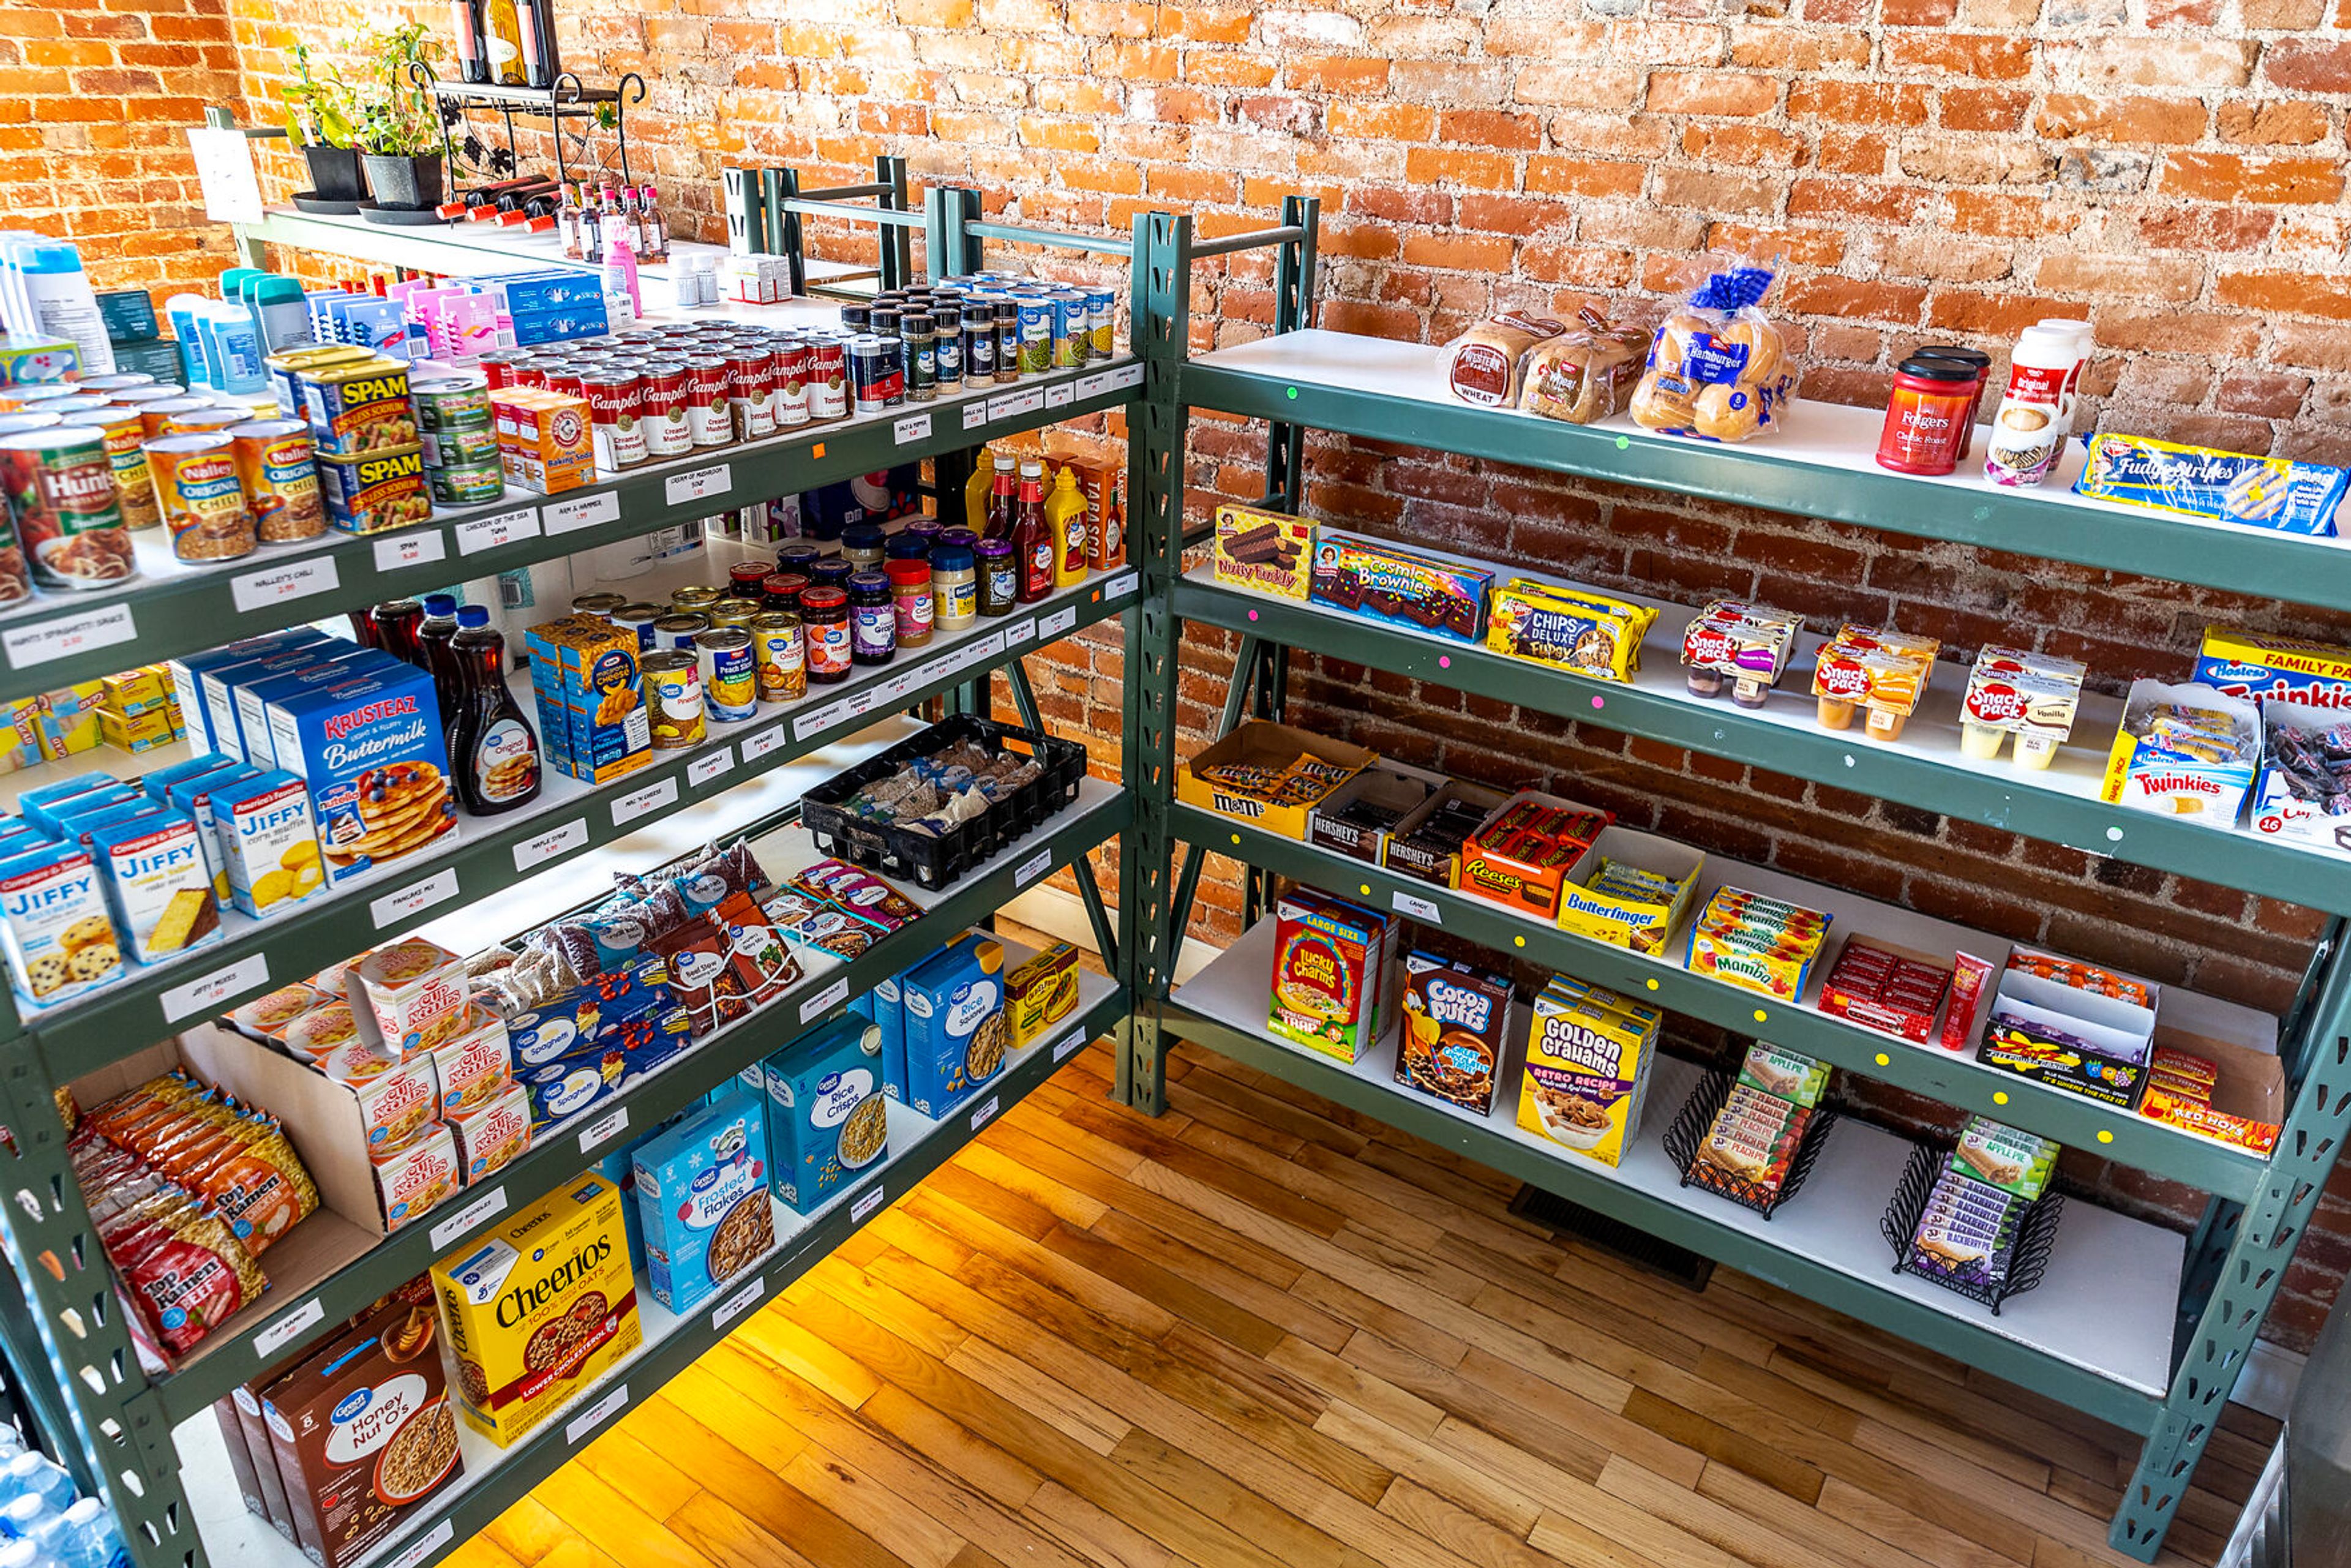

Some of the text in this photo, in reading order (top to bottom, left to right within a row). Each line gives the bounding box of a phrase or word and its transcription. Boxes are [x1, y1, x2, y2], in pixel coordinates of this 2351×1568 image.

[1690, 348, 1742, 367] Hamburger
[343, 376, 408, 404] SPAM
[1462, 388, 1493, 402] WHEAT
[1734, 394, 1741, 404] 8
[782, 402, 806, 411] Tomato
[1902, 411, 1949, 429] Folgers
[185, 462, 232, 480] Nalley
[361, 454, 422, 483] SPAM
[549, 451, 593, 467] Baking Soda
[184, 480, 239, 497] ORIGINAL
[198, 495, 238, 511] CHILI
[1088, 482, 1100, 557] TABASCO
[1359, 568, 1433, 596] Brownies
[1371, 558, 1425, 582] Cosmic
[1533, 613, 1577, 632] CHIPS
[1532, 629, 1575, 645] DELUXE
[1687, 634, 1733, 651] Snack
[1820, 664, 1869, 682] Snack
[2215, 664, 2267, 678] Hostess
[2264, 653, 2351, 680] FAMILY PA
[1971, 690, 2024, 706] Snack
[324, 696, 421, 740] KRUSTEAZ
[2037, 708, 2066, 718] Vanilla
[323, 718, 427, 770] Buttermilk
[495, 739, 523, 754] Original
[2142, 754, 2175, 765] Hostess
[274, 784, 304, 800] Favorite
[2135, 773, 2222, 795] Twinkies
[319, 790, 360, 811] nutella
[241, 802, 306, 836] JIFFY
[1314, 817, 1359, 844] HERSHEY'S
[2262, 819, 2279, 830] 16
[247, 819, 306, 846] corn muffin
[270, 835, 290, 847] mix
[120, 843, 196, 879] JIFFY
[1390, 842, 1434, 866] HERSHEY'S
[1466, 860, 1522, 888] Reese's
[10, 876, 91, 915] JIFFY
[1567, 893, 1655, 926] Butterfinger
[1307, 915, 1359, 942] LARGE SIZE
[1741, 914, 1786, 932] Mamba
[1723, 935, 1768, 953] Mamba
[1300, 948, 1335, 973] Lucky
[1716, 957, 1771, 983] Mamba
[1294, 961, 1336, 989] Charms
[408, 989, 461, 1026] NOODLES
[419, 984, 450, 1009] CUP
[961, 995, 983, 1015] Rice
[1428, 980, 1491, 1013] Cocoa
[959, 1005, 986, 1027] Squares
[1282, 1015, 1318, 1034] TRAP
[531, 1031, 569, 1056] Spaghetti
[449, 1051, 502, 1086] NOODLES
[460, 1045, 490, 1070] CUP
[1769, 1056, 1803, 1074] APPLE PIE
[1534, 1068, 1617, 1090] RETRO RECIPE
[2057, 1079, 2083, 1092] WHERE
[2084, 1087, 2098, 1097] THE
[374, 1083, 429, 1122] NOODLES
[386, 1078, 416, 1105] CUP
[558, 1082, 594, 1106] Spaghetti
[831, 1084, 855, 1104] Rice
[827, 1093, 859, 1119] Crisps
[1749, 1111, 1771, 1125] PEACH
[486, 1112, 512, 1136] CUP
[1740, 1120, 1777, 1139] PEACH PIE
[2174, 1108, 2245, 1136] RED HOTS
[474, 1115, 523, 1155] NOODLES
[1731, 1142, 1766, 1162] PEACH PIE
[1986, 1141, 2025, 1162] APPLE PIE
[407, 1154, 435, 1178] CUP
[394, 1159, 449, 1199] NOODLES
[694, 1170, 718, 1187] Great
[698, 1172, 746, 1209] Frosted
[216, 1184, 245, 1207] Top
[225, 1173, 280, 1221] Ramen
[247, 1191, 282, 1220] CHICKEN
[704, 1186, 744, 1219] Flakes
[511, 1211, 551, 1239] Cheerios
[1947, 1231, 1992, 1251] BLACKBERRY PIE
[141, 1269, 180, 1297] Top
[157, 1256, 219, 1311] Ramen
[496, 1234, 610, 1329] Cheerios
[577, 1266, 604, 1290] OATS
[184, 1279, 216, 1310] BEEF
[444, 1287, 468, 1353] Cheerios
[528, 1303, 558, 1326] 100%
[523, 1329, 606, 1399] LOWER CHOLESTEROL
[336, 1393, 367, 1417] Great
[352, 1391, 403, 1435] Honey
[304, 1416, 313, 1427] 8
[353, 1404, 409, 1449] Nut O's
